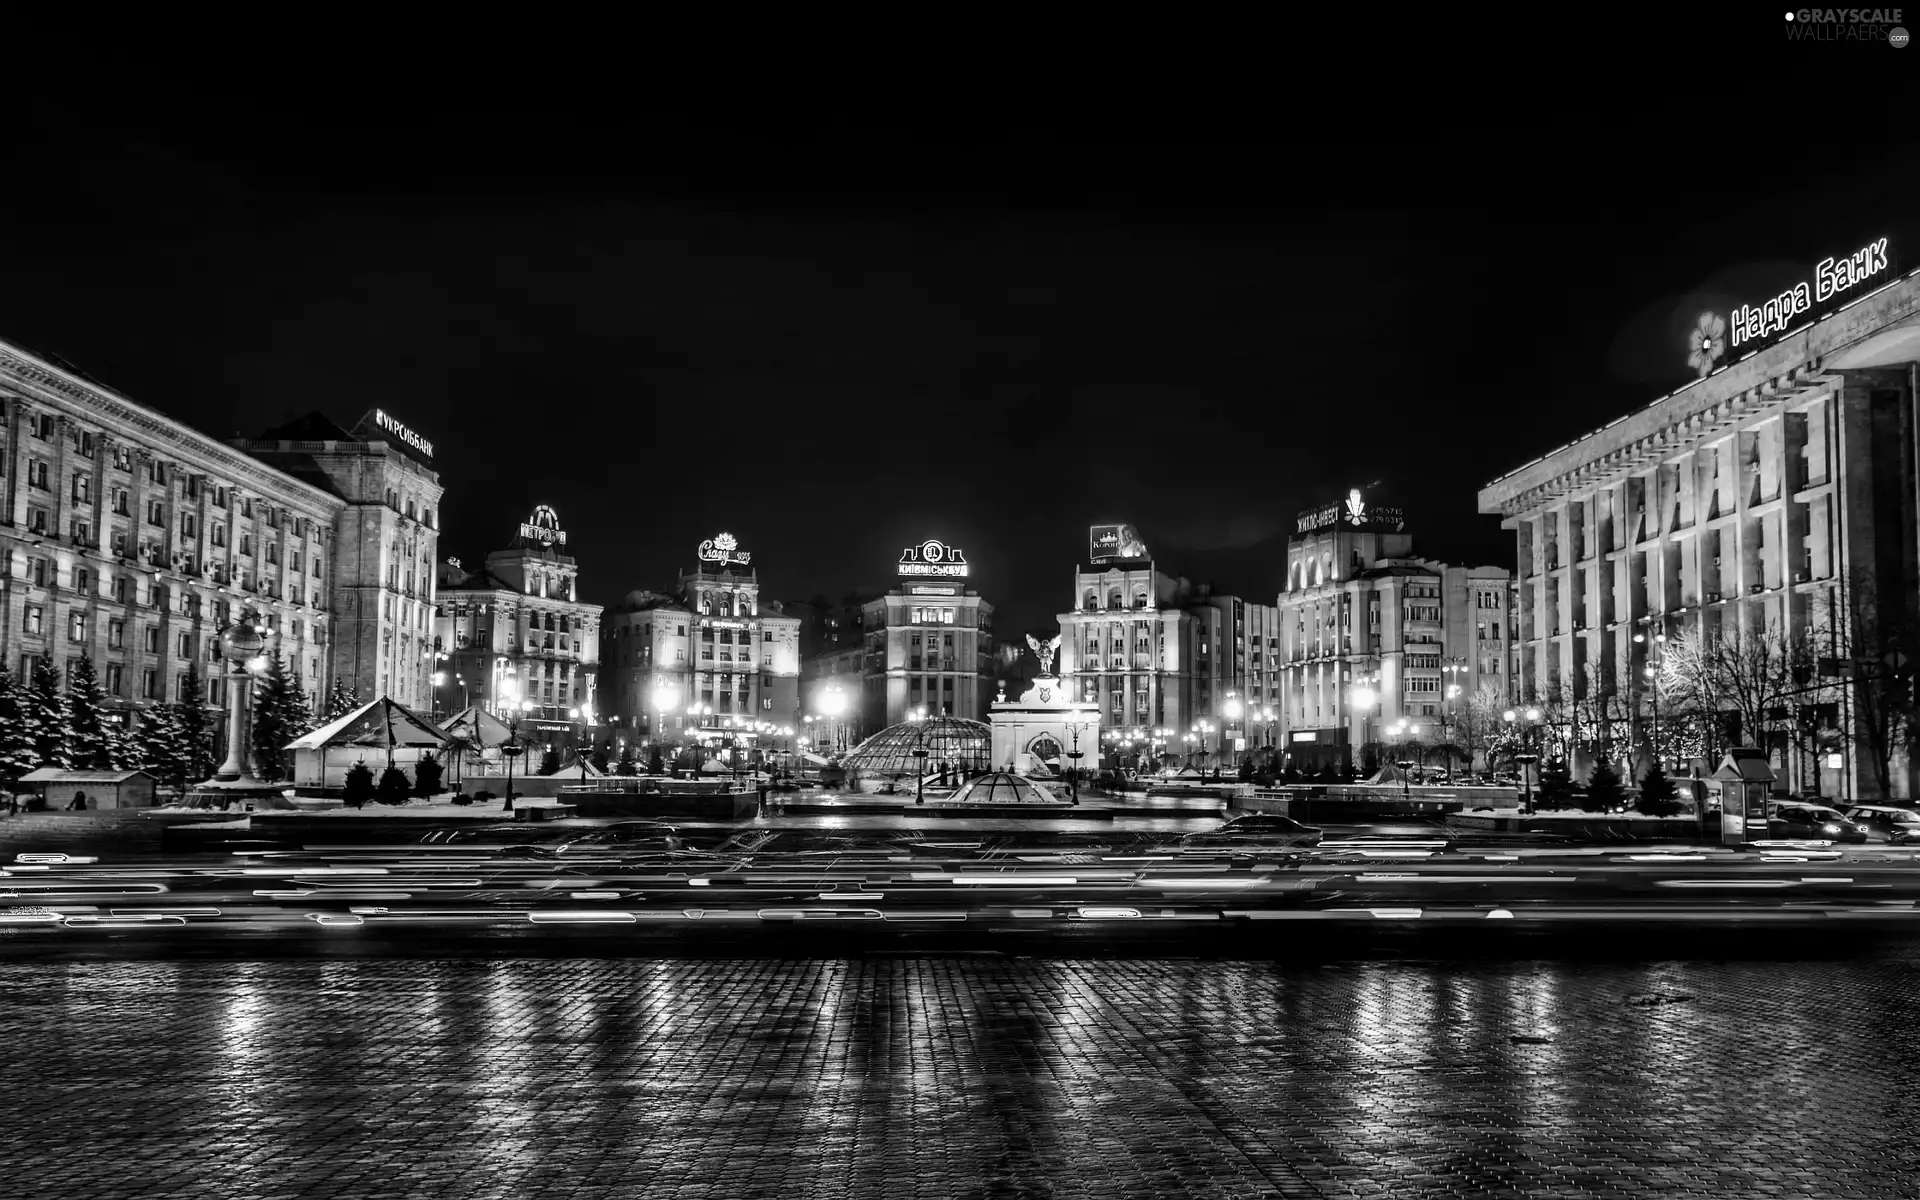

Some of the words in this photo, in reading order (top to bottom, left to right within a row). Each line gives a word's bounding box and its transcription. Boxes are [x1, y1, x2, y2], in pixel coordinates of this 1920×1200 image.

[1731, 282, 1811, 347] Надра
[1816, 237, 1888, 302] Банк
[383, 412, 434, 458] УКРСИББАНК
[698, 539, 730, 567] Crazy
[898, 563, 968, 576] КИЇВМІСЬКБУД
